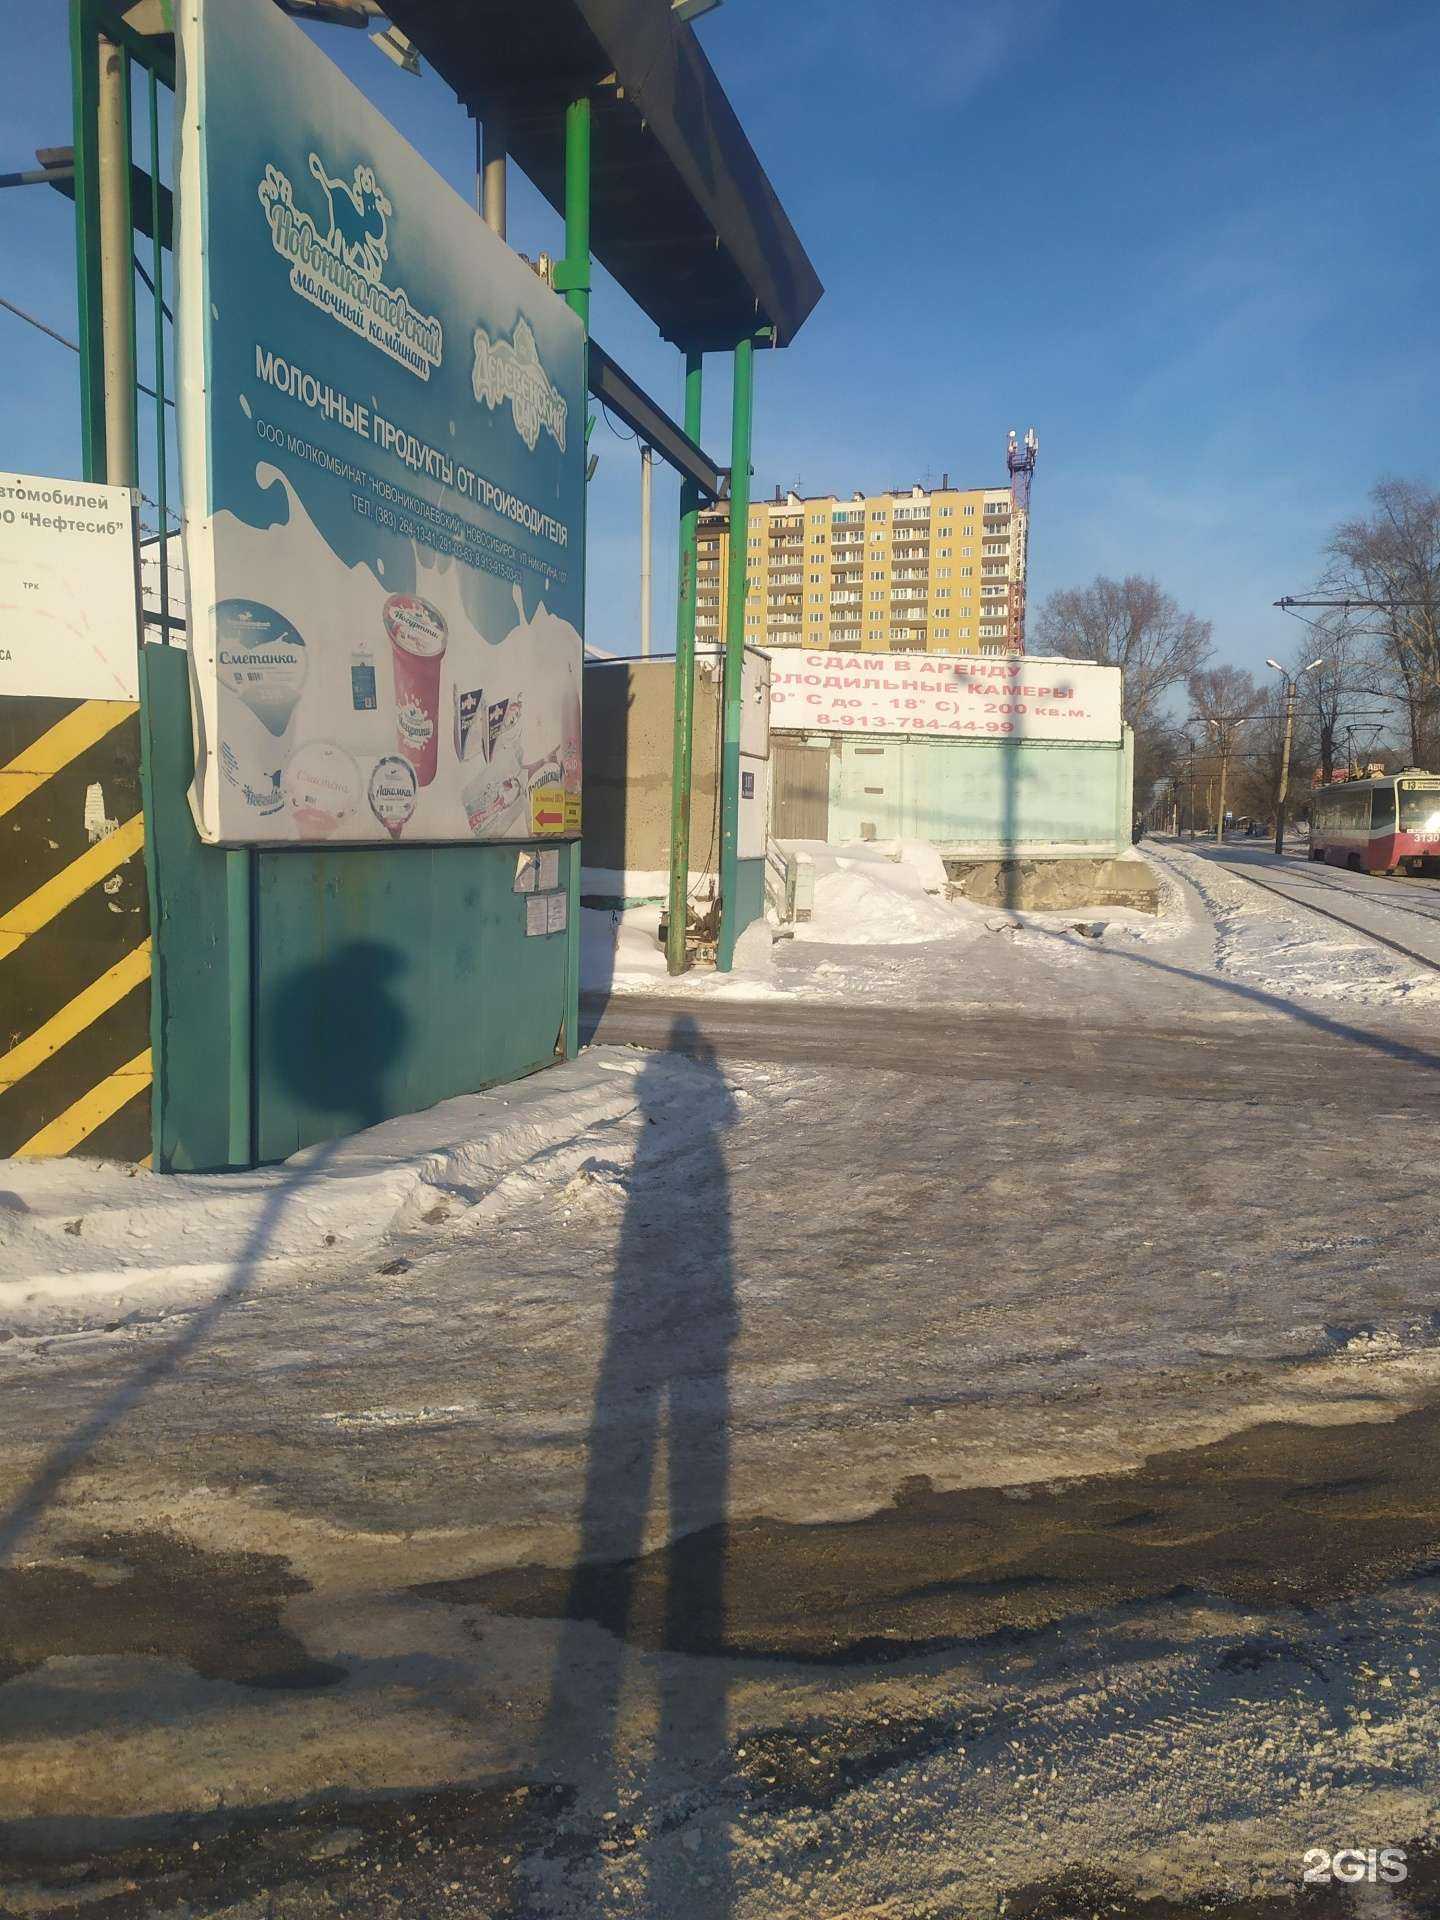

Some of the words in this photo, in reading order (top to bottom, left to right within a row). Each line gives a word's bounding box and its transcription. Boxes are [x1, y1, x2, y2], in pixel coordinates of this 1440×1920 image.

[294, 270, 365, 330] молочный
[369, 319, 428, 375] комбинат
[255, 344, 370, 438] МОЛОЧНЫЕ
[373, 415, 453, 486] ПРОДУКТЫ
[457, 466, 475, 496] ОТ
[477, 478, 568, 547] ПРОИЗВОДИТЕЛЯ
[256, 420, 285, 447] ООО
[287, 434, 366, 487] МОЛКОМБИНАТ
[0, 509, 15, 524] О
[375, 505, 397, 533] (383)
[23, 581, 39, 590] ТРК
[219, 651, 297, 665] Сметанка
[806, 655, 884, 671] СДАМ
[894, 660, 911, 671] В
[919, 662, 1022, 679] АРЕНДУ
[967, 683, 1074, 699] КАМЕРЫ
[831, 698, 862, 709] до
[984, 703, 1028, 715] 200
[816, 713, 1014, 733] 8-913-784-44-99
